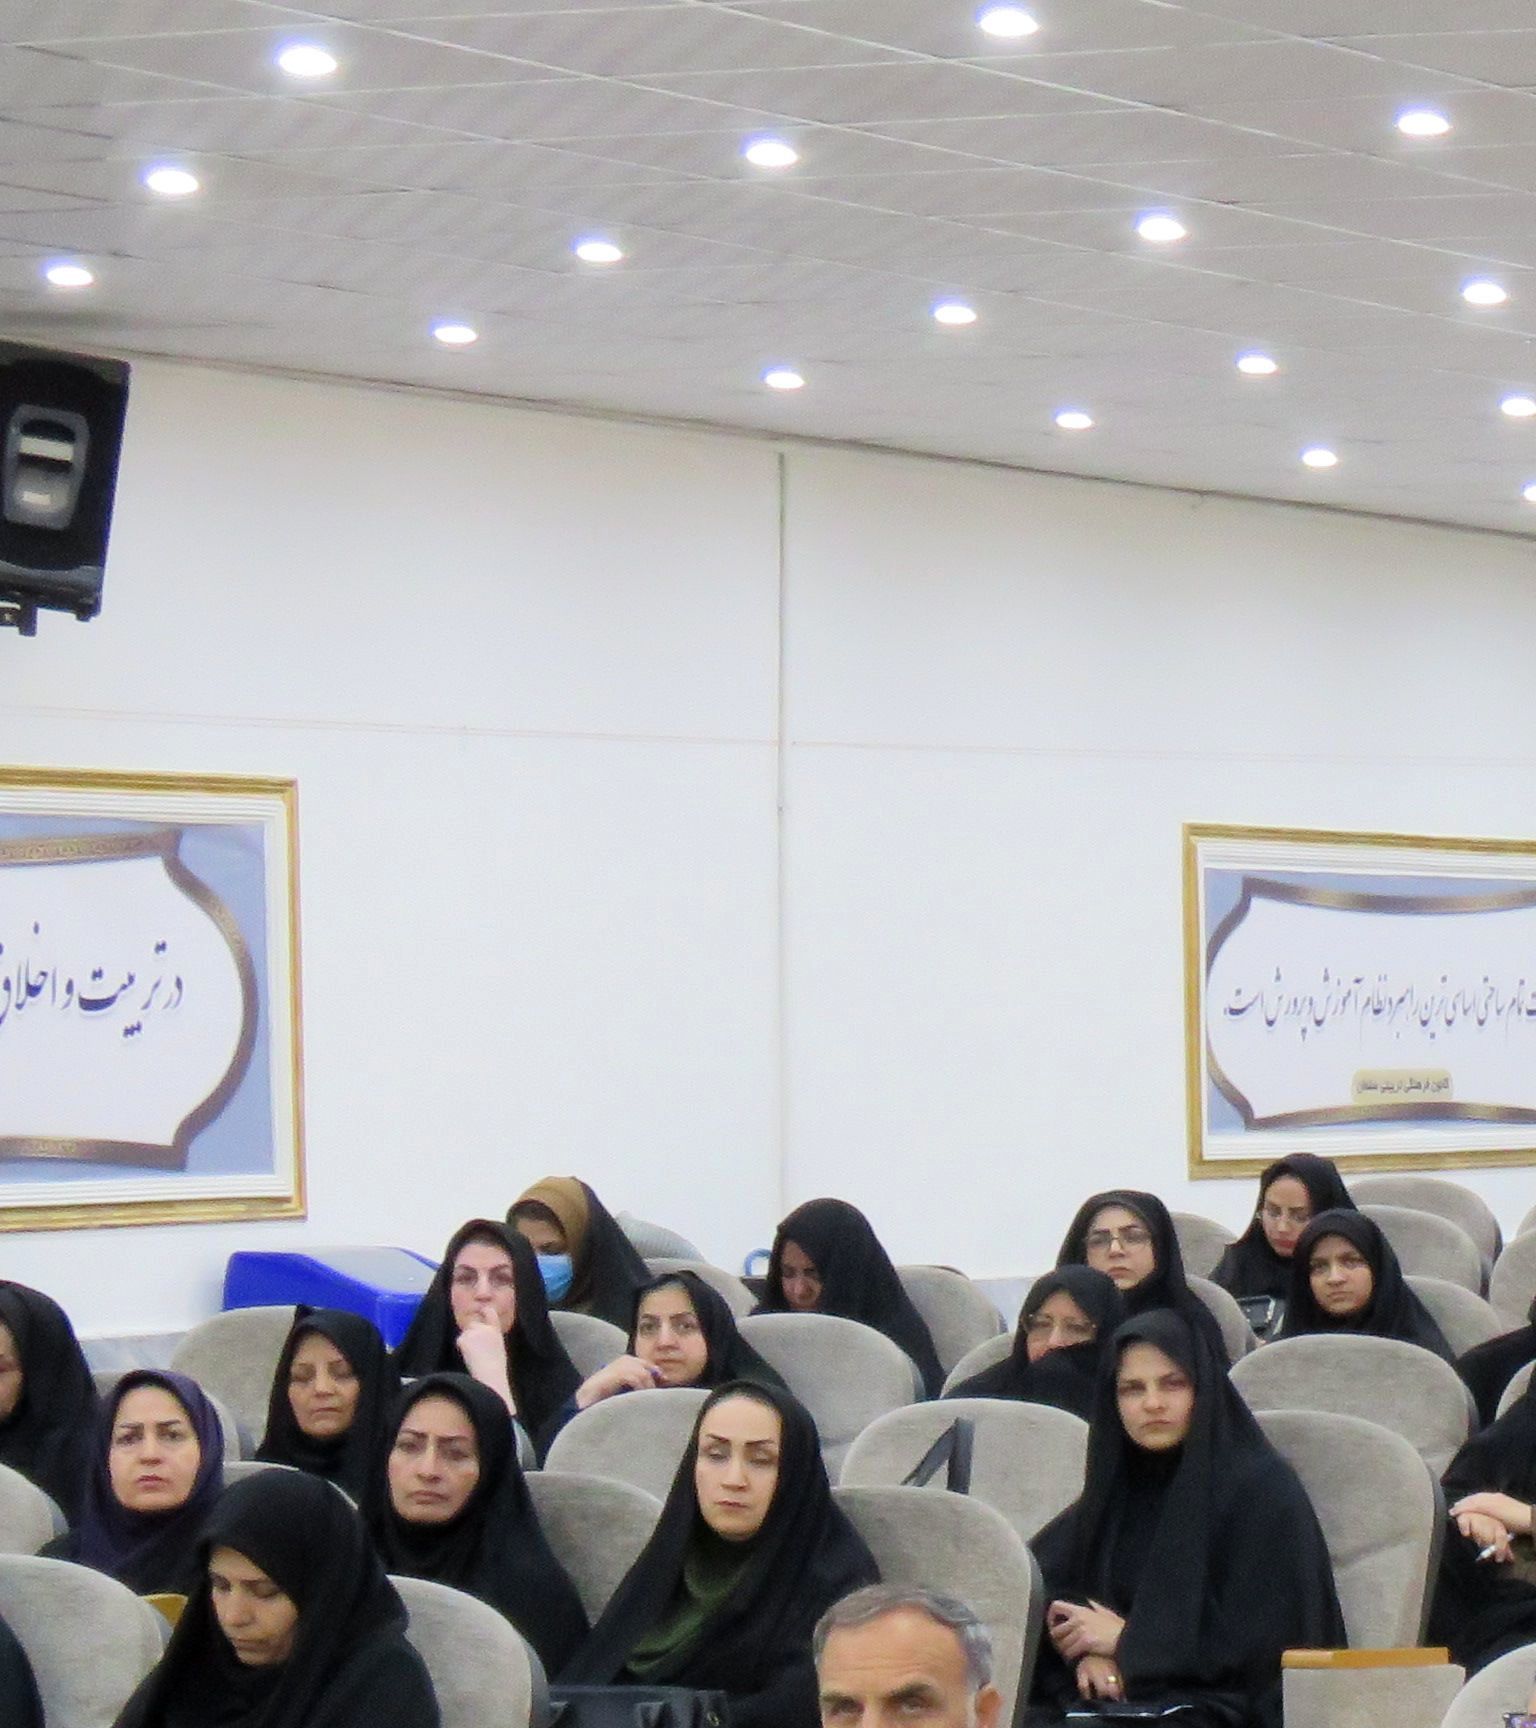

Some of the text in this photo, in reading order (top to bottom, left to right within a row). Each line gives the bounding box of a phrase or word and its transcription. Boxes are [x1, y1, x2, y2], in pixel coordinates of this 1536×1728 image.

[61, 977, 75, 1011] و
[77, 940, 168, 1039] تربیت
[162, 975, 184, 1011] در
[1263, 965, 1307, 1043] پرورش
[1312, 967, 1365, 1029] آموزش
